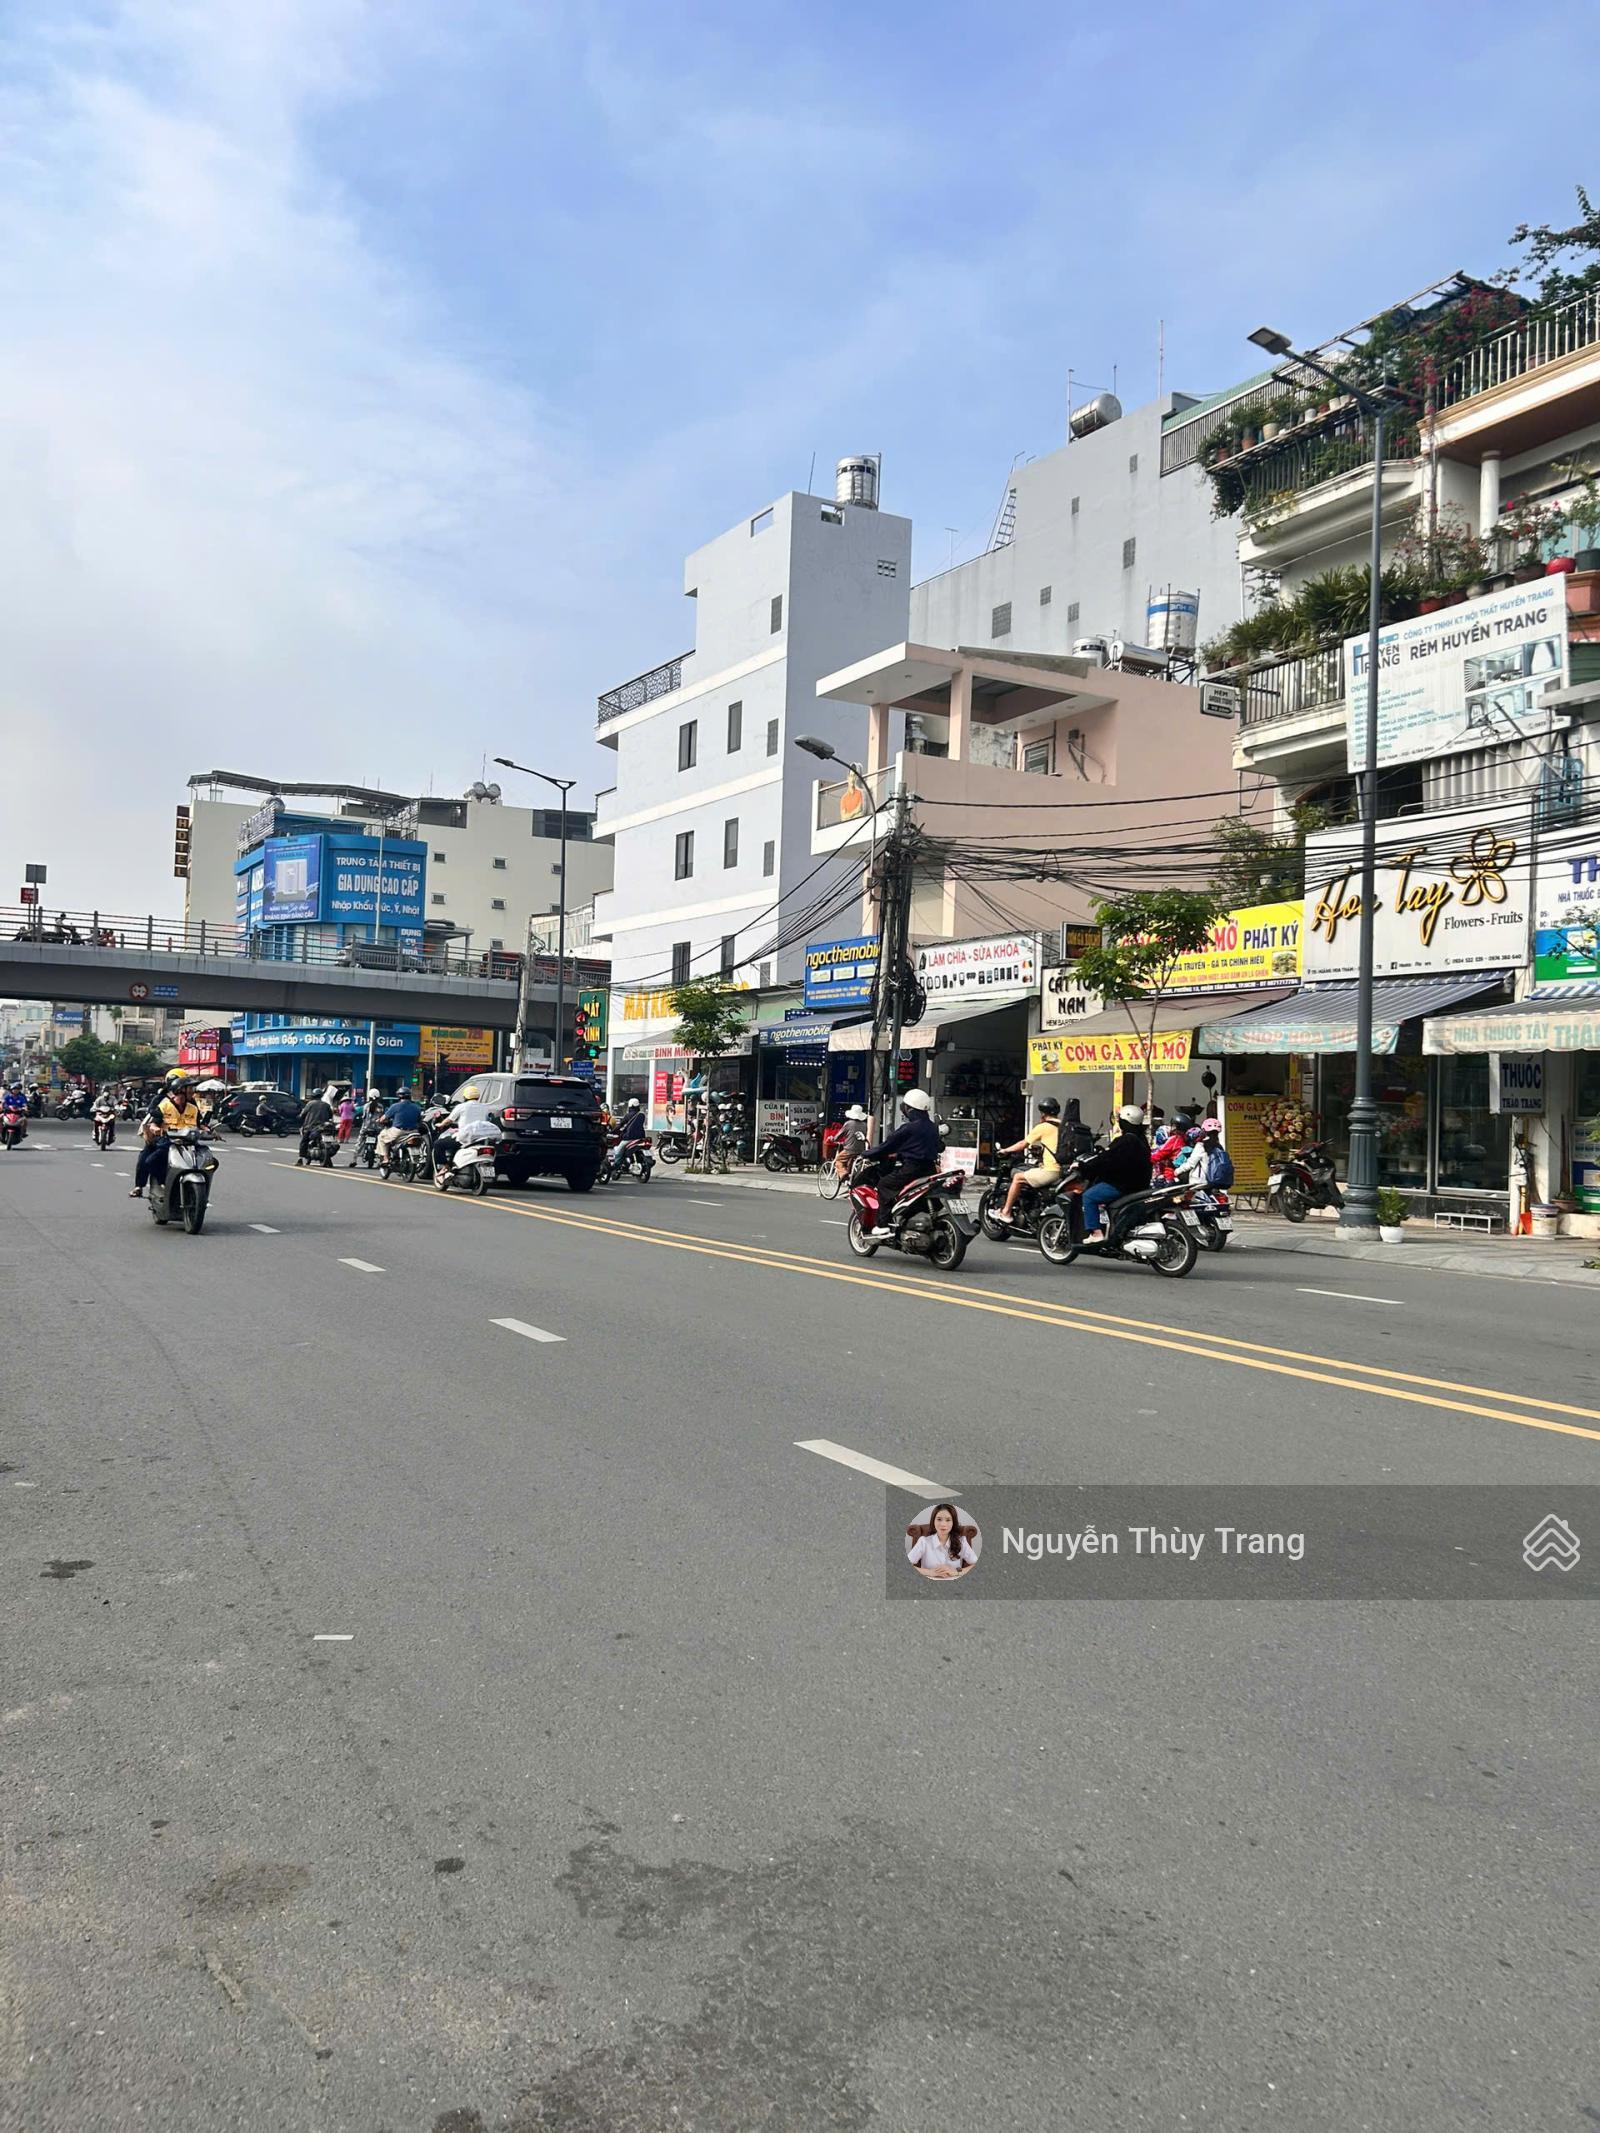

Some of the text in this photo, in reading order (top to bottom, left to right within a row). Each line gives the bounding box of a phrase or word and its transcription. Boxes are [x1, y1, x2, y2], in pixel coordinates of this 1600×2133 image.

[1410, 608, 1548, 661] RÈM HUYỀN TRANG
[177, 818, 187, 876] HOTEL
[336, 857, 367, 867] TRUNG
[337, 875, 419, 897] GIA DỤNG CAO CẤP
[1244, 923, 1278, 950] PHÁT
[1281, 919, 1299, 947] KÝ
[928, 940, 1020, 967] LÀM CHÌA SỬA KHÓA
[1058, 996, 1087, 1014] NAM
[304, 1032, 326, 1046] Ghế
[327, 1032, 351, 1048] Xếp
[1065, 1041, 1097, 1062] CƠM
[1101, 1039, 1124, 1061] GÀ
[1162, 1036, 1188, 1060] MỠ
[1502, 1055, 1542, 1089] THUỐC
